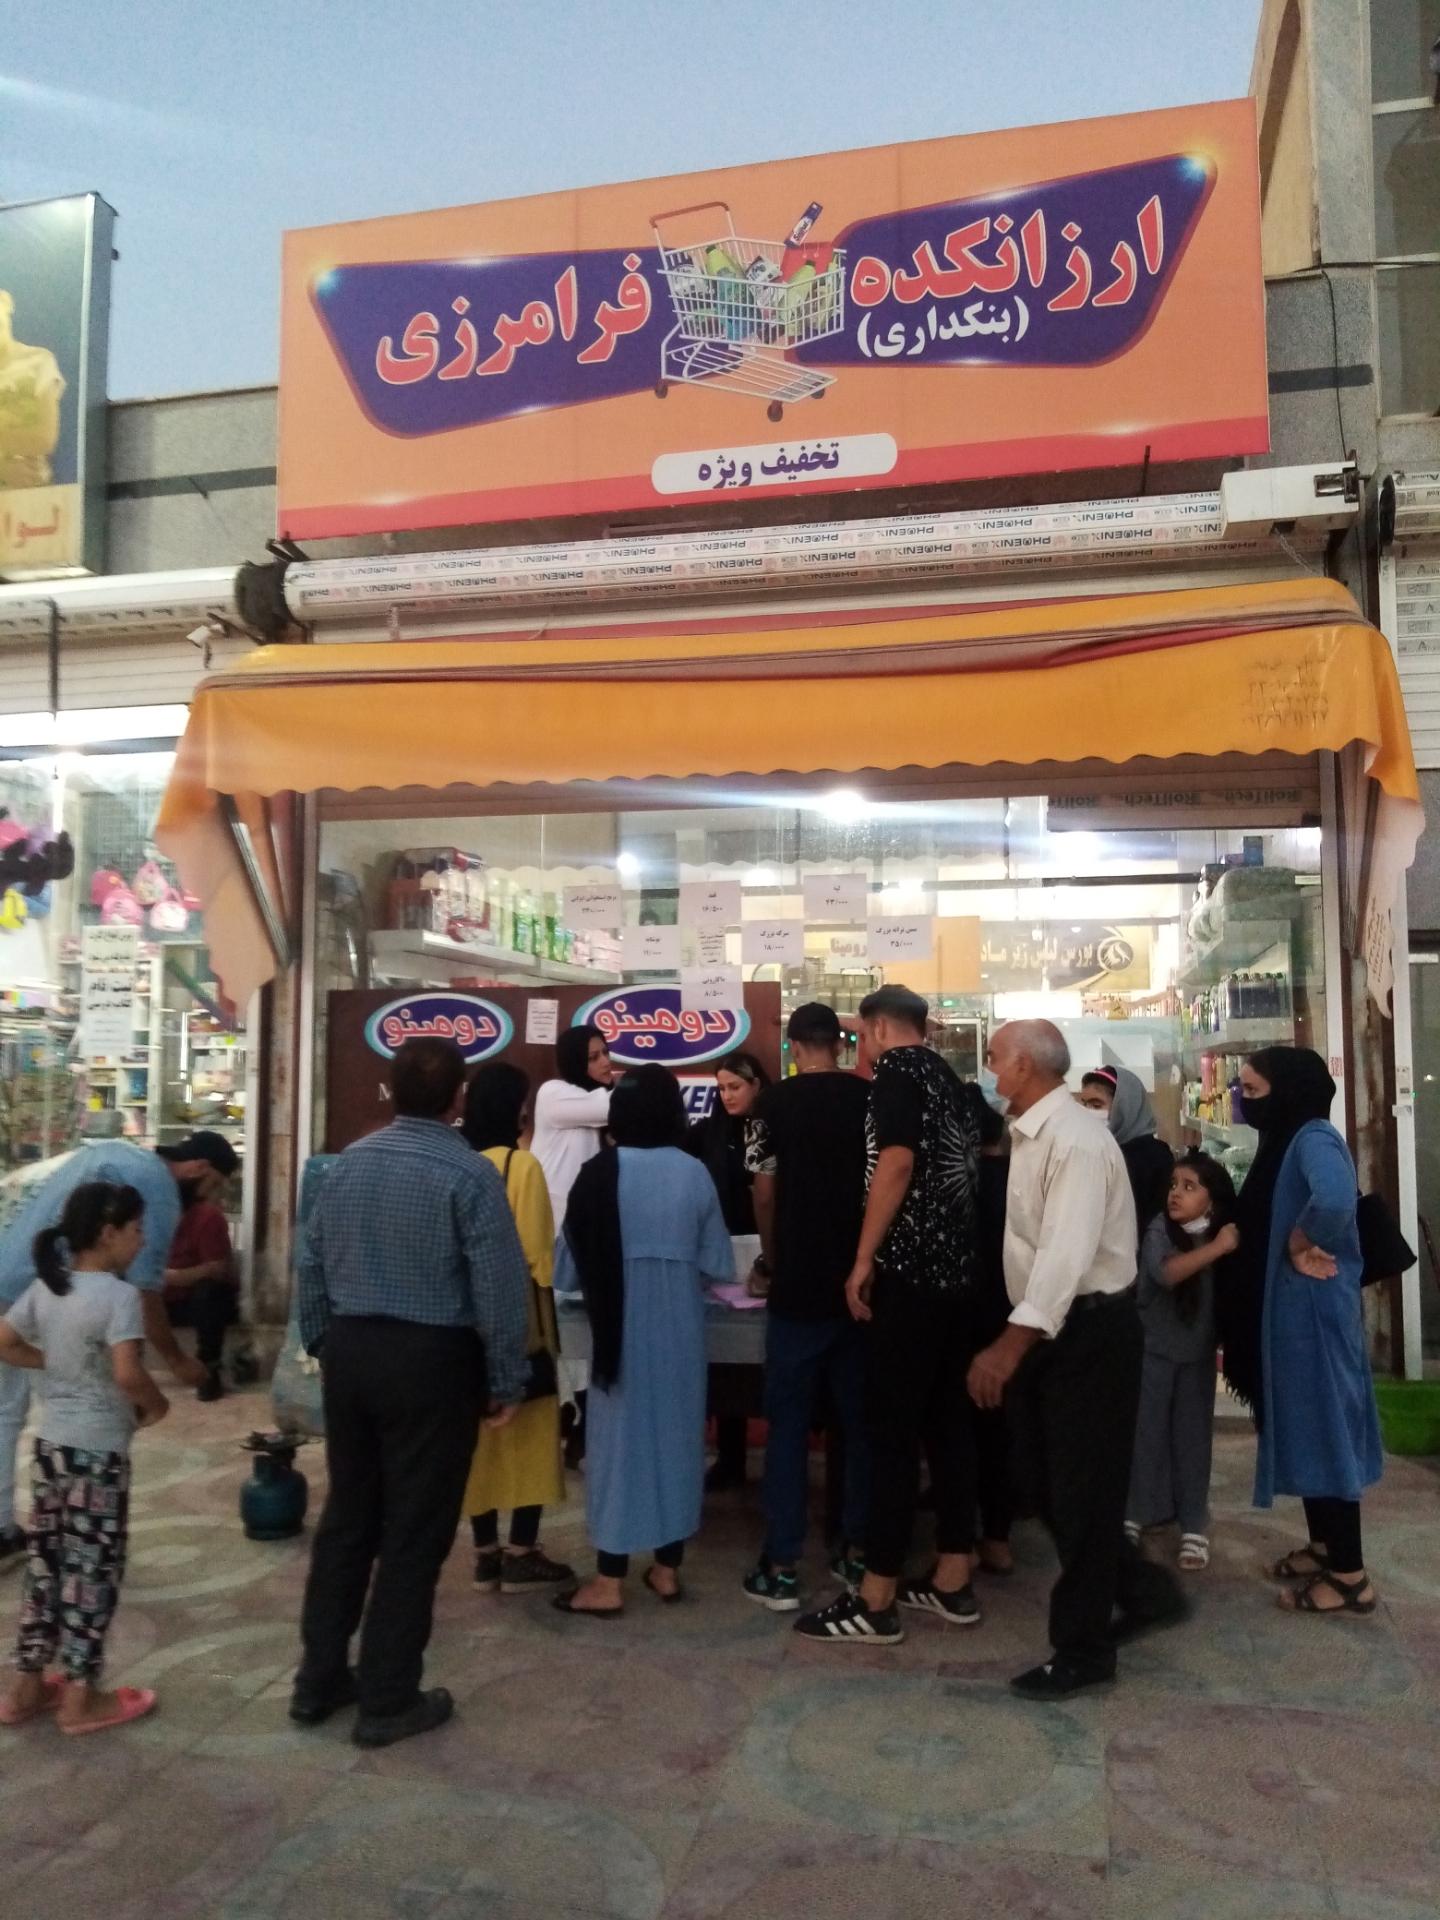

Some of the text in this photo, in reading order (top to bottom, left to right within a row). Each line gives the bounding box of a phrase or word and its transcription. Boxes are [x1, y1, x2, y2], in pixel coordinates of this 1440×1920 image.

[375, 193, 1165, 386] ارزانکده فرامرزی
[856, 295, 1030, 358] (بنکداری)
[698, 442, 839, 489] تخفیف ویژه
